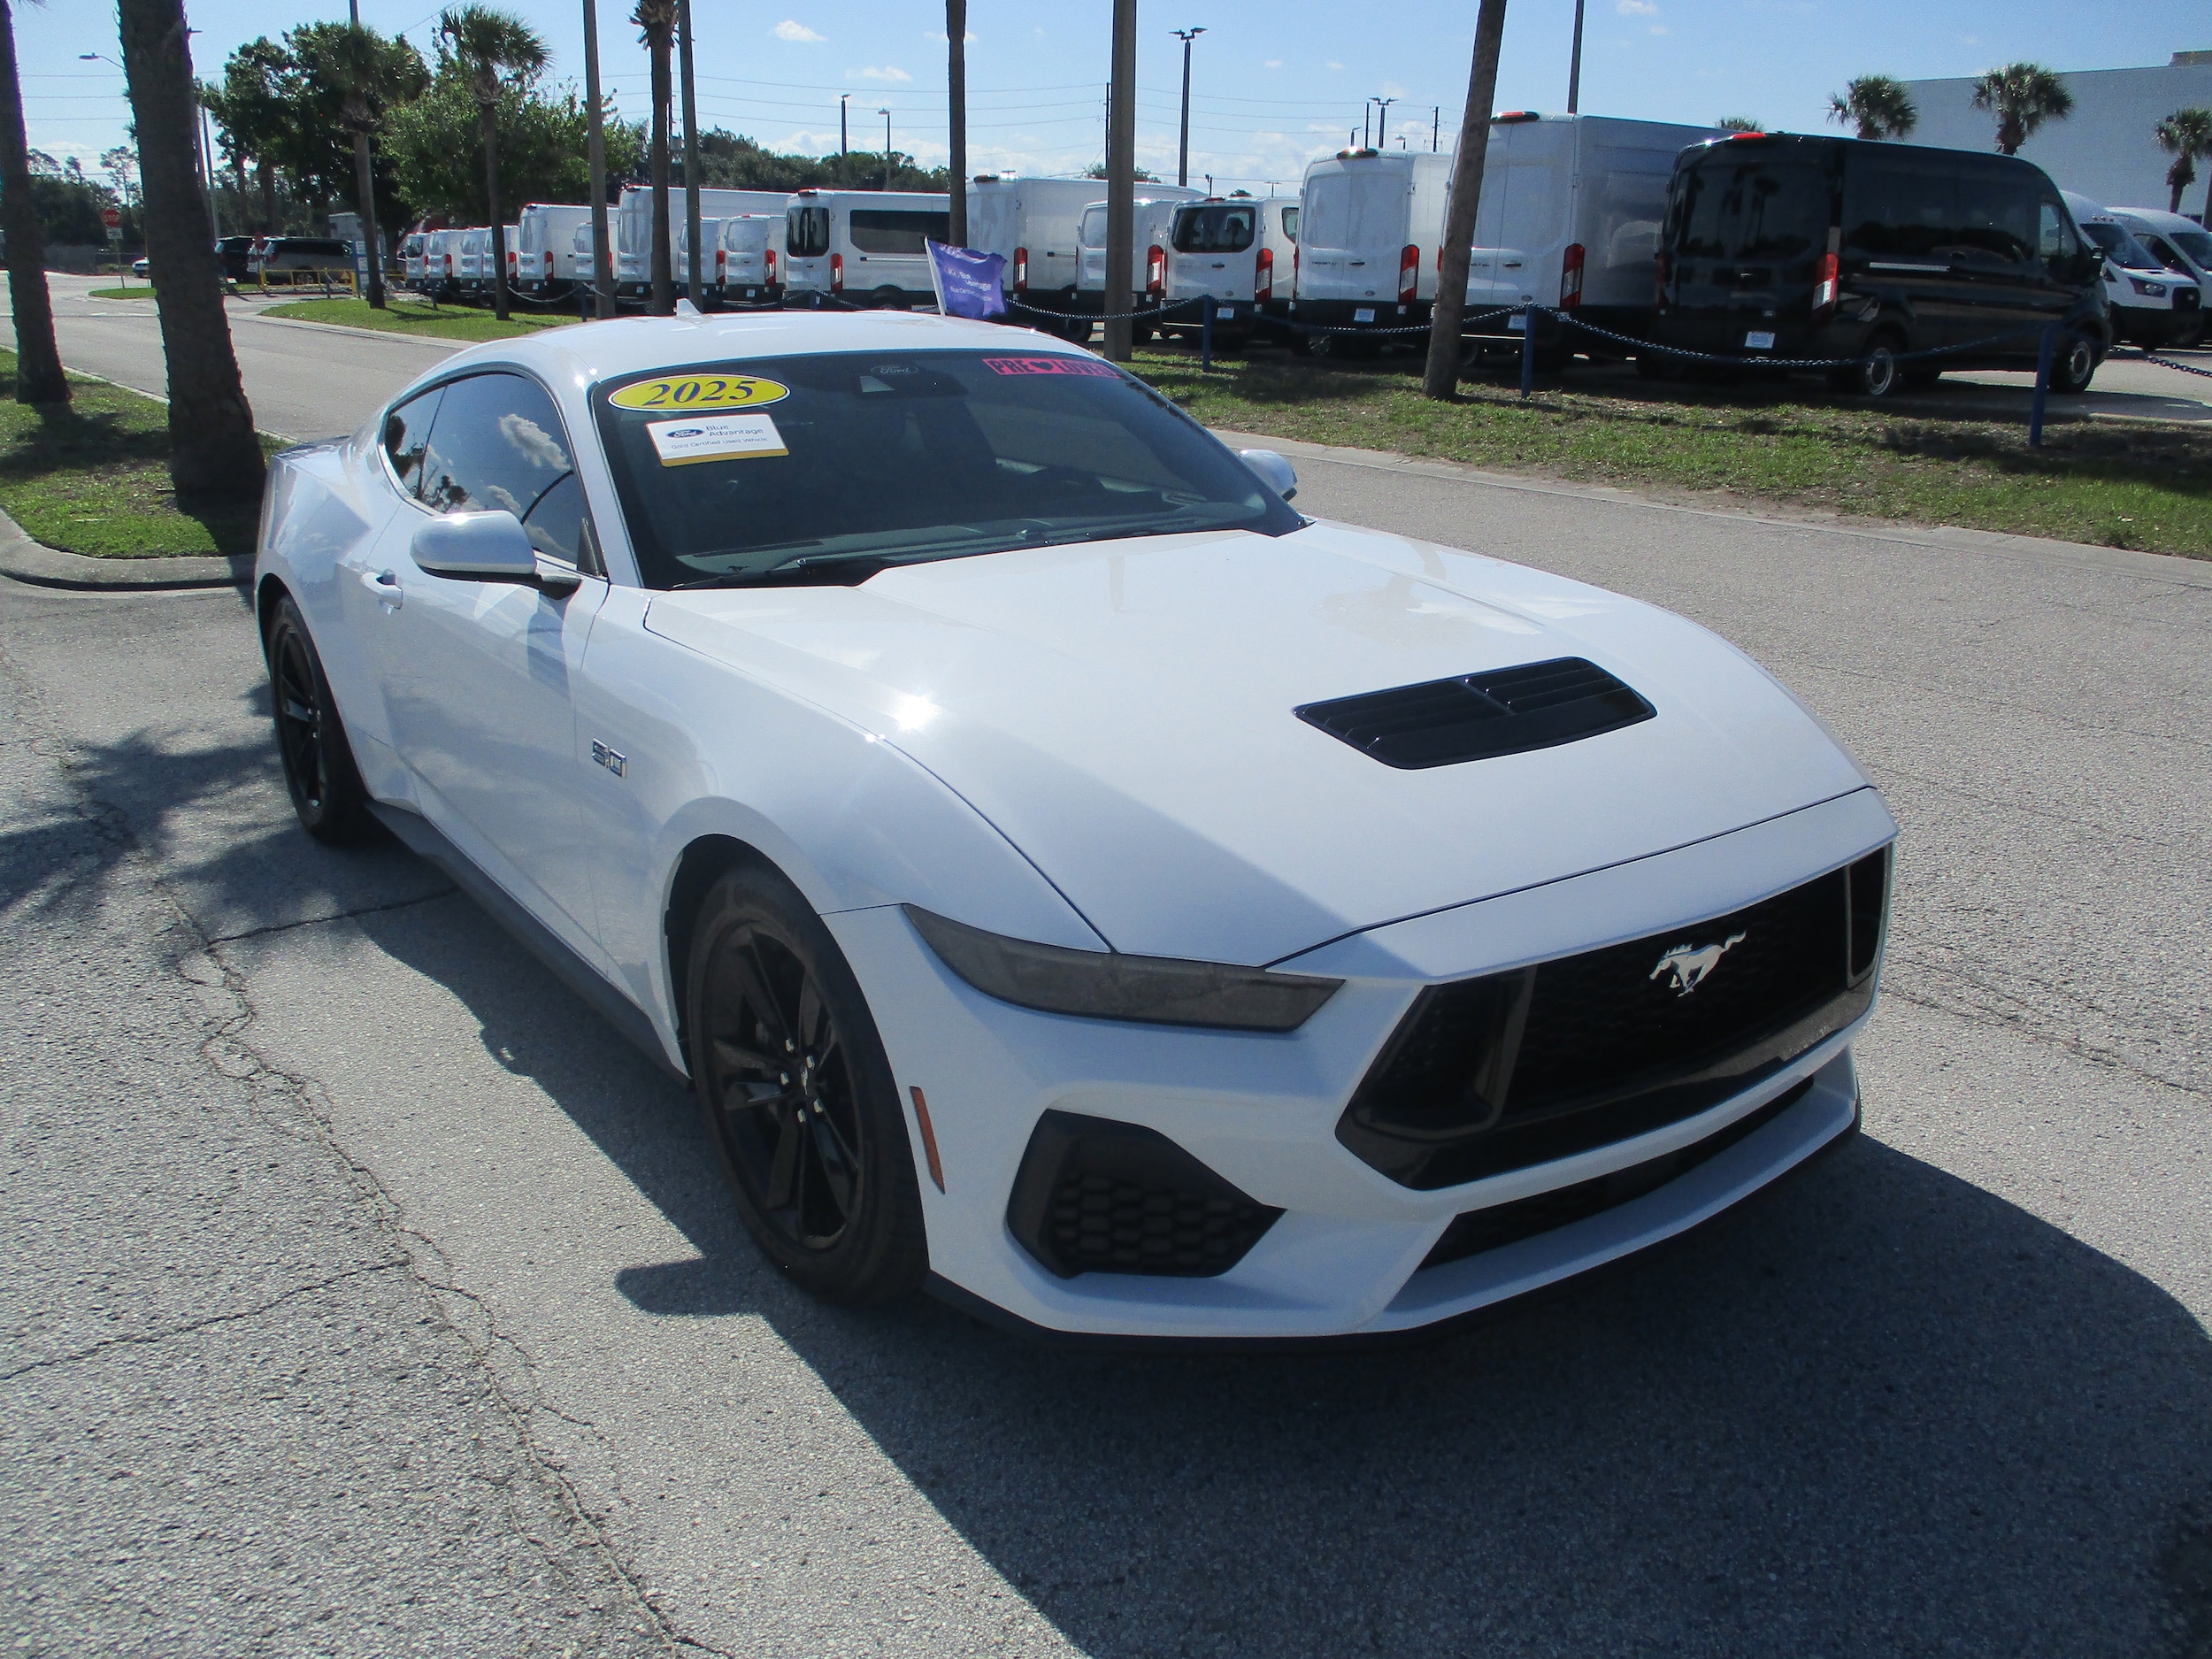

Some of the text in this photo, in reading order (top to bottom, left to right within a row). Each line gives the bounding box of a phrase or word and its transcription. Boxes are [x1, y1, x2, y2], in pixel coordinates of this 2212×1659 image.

[987, 359, 1035, 373] PRE
[641, 380, 757, 406] 2025
[709, 428, 764, 437] Advantage
